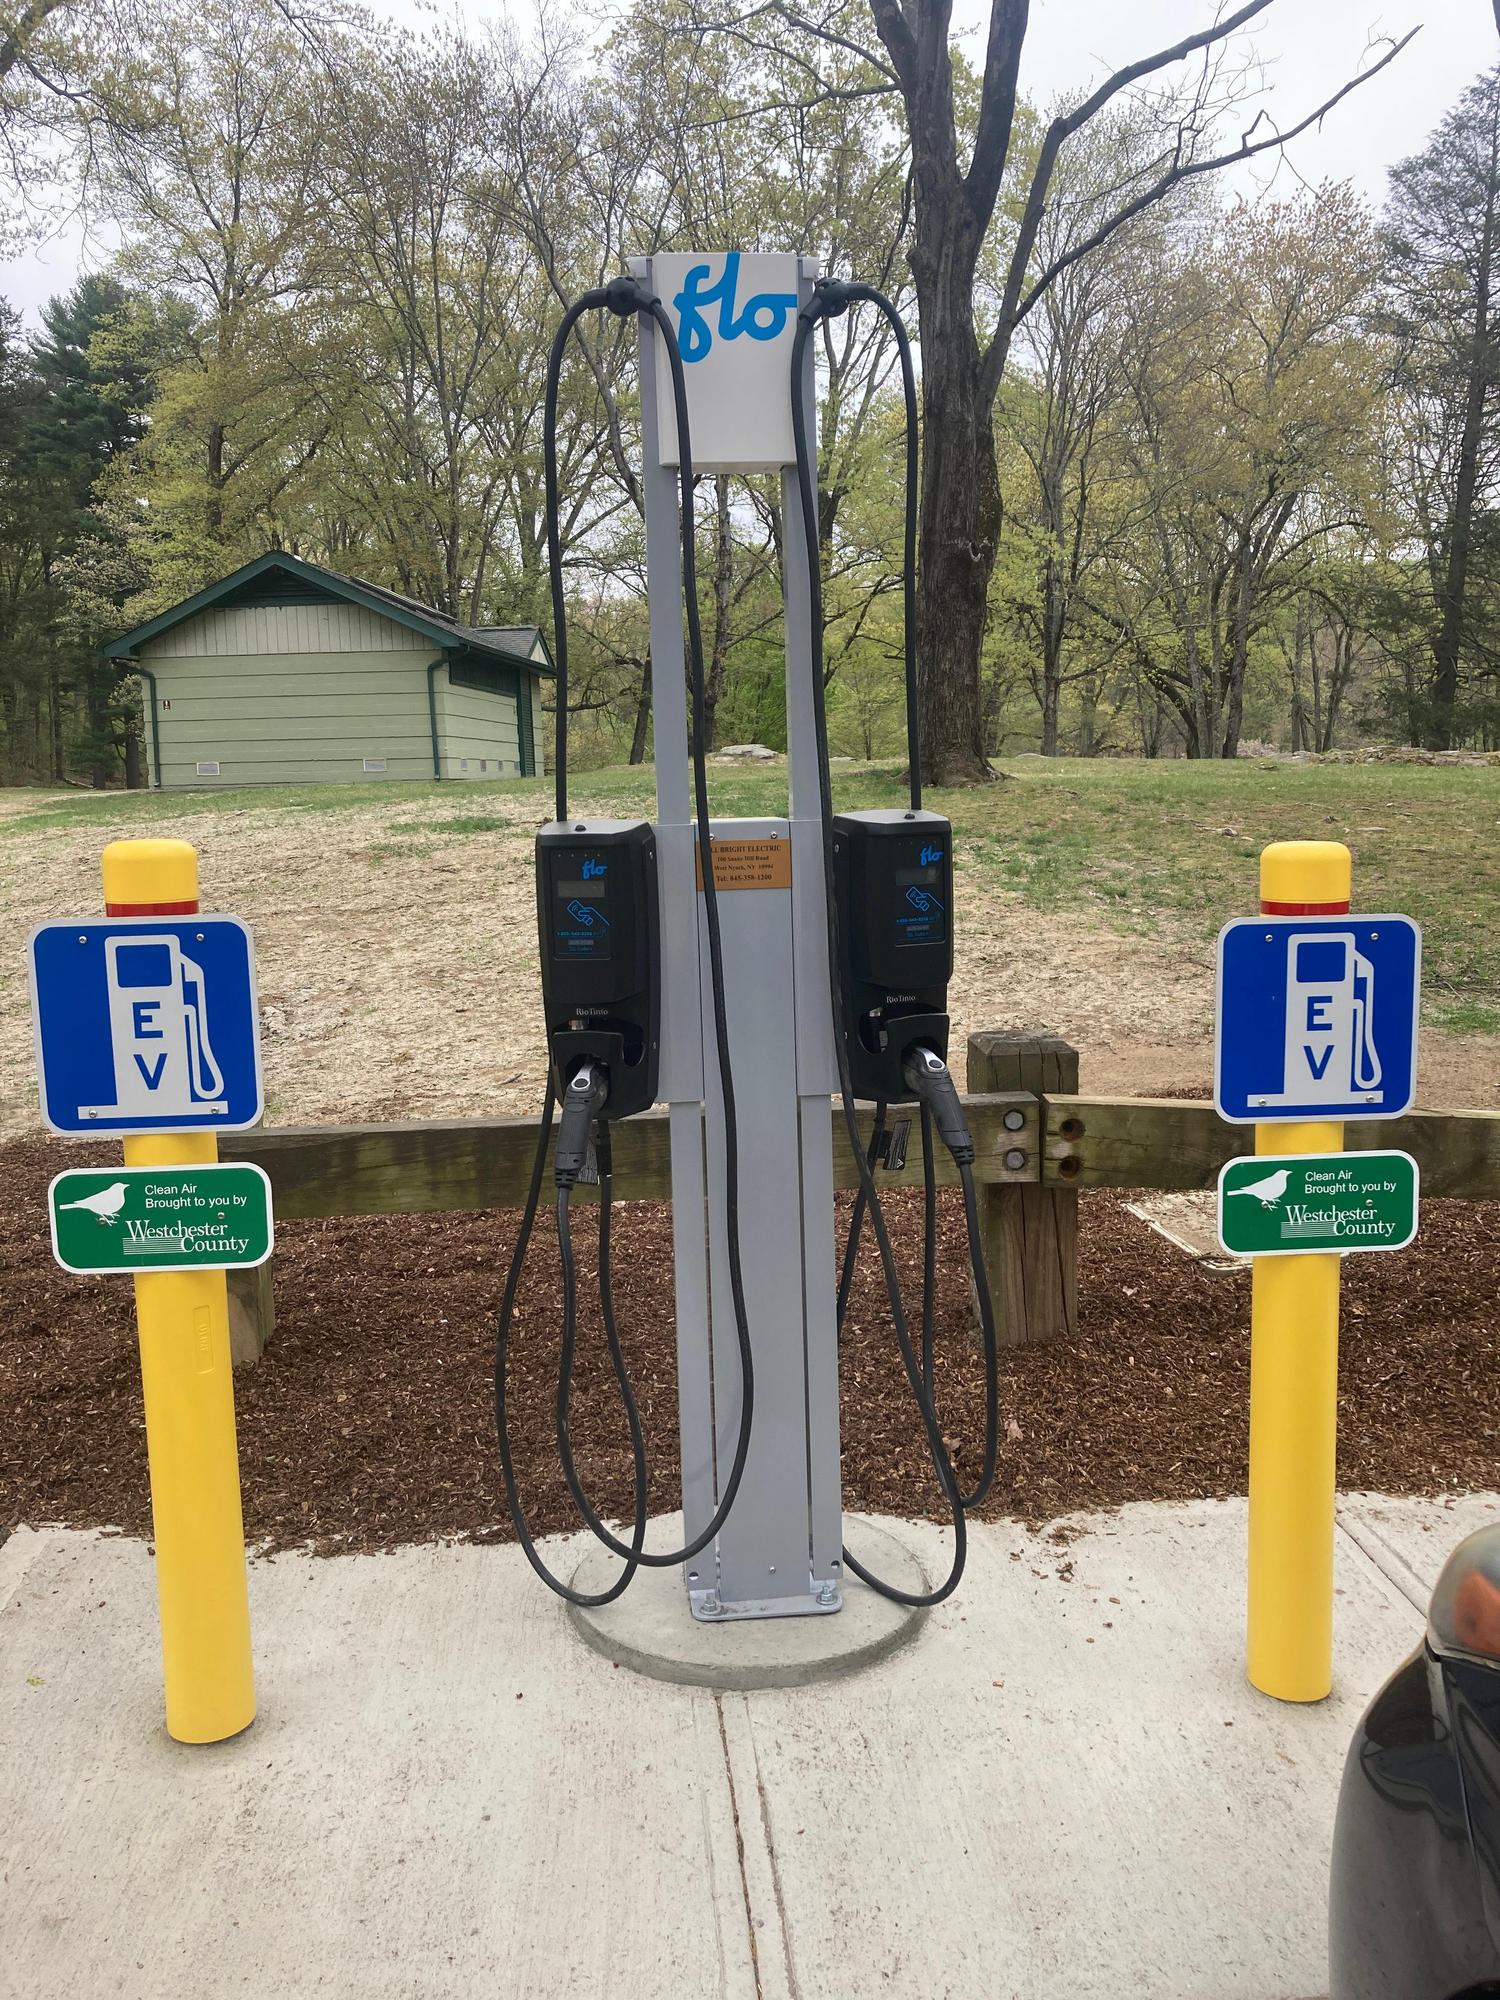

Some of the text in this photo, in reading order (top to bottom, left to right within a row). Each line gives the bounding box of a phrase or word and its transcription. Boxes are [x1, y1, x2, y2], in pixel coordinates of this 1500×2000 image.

[673, 251, 798, 364] flo
[920, 846, 944, 866] flo
[582, 859, 608, 880] flo
[1305, 1170, 1353, 1181] Clean Air
[144, 1183, 198, 1195] Clean Air
[1304, 1181, 1397, 1195] Brought to you by
[145, 1195, 247, 1210] Brought to you by
[1284, 1204, 1378, 1226] Westchester
[125, 1219, 229, 1242] Westchester
[1333, 1220, 1396, 1237] County
[180, 1235, 250, 1254] County
